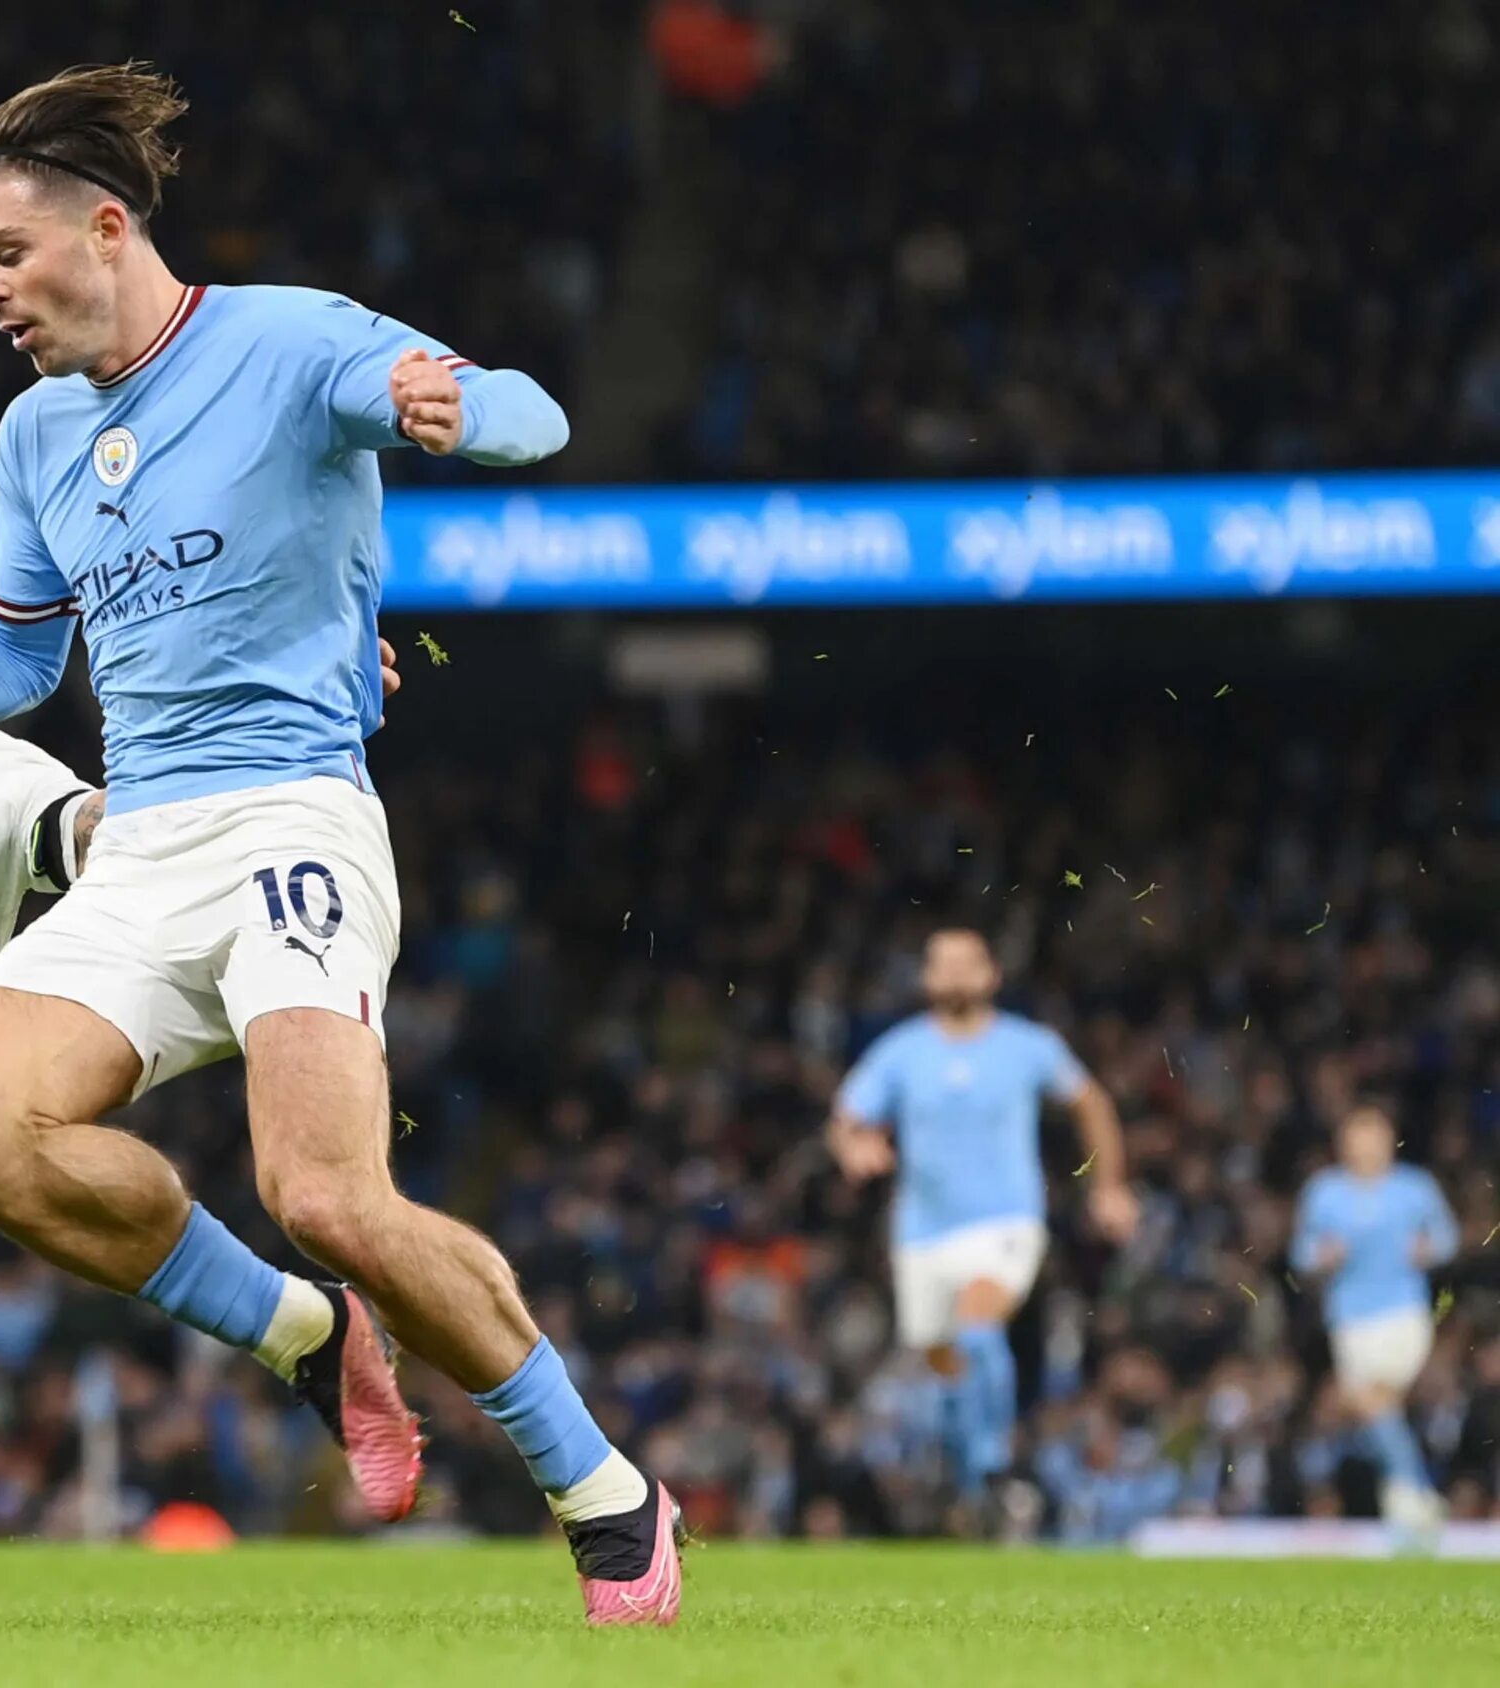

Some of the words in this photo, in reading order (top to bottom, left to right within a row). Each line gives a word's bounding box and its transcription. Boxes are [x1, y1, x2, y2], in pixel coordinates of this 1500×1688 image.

[72, 529, 223, 609] TIHAD
[90, 585, 184, 631] RWAYS
[253, 861, 343, 939] 10
